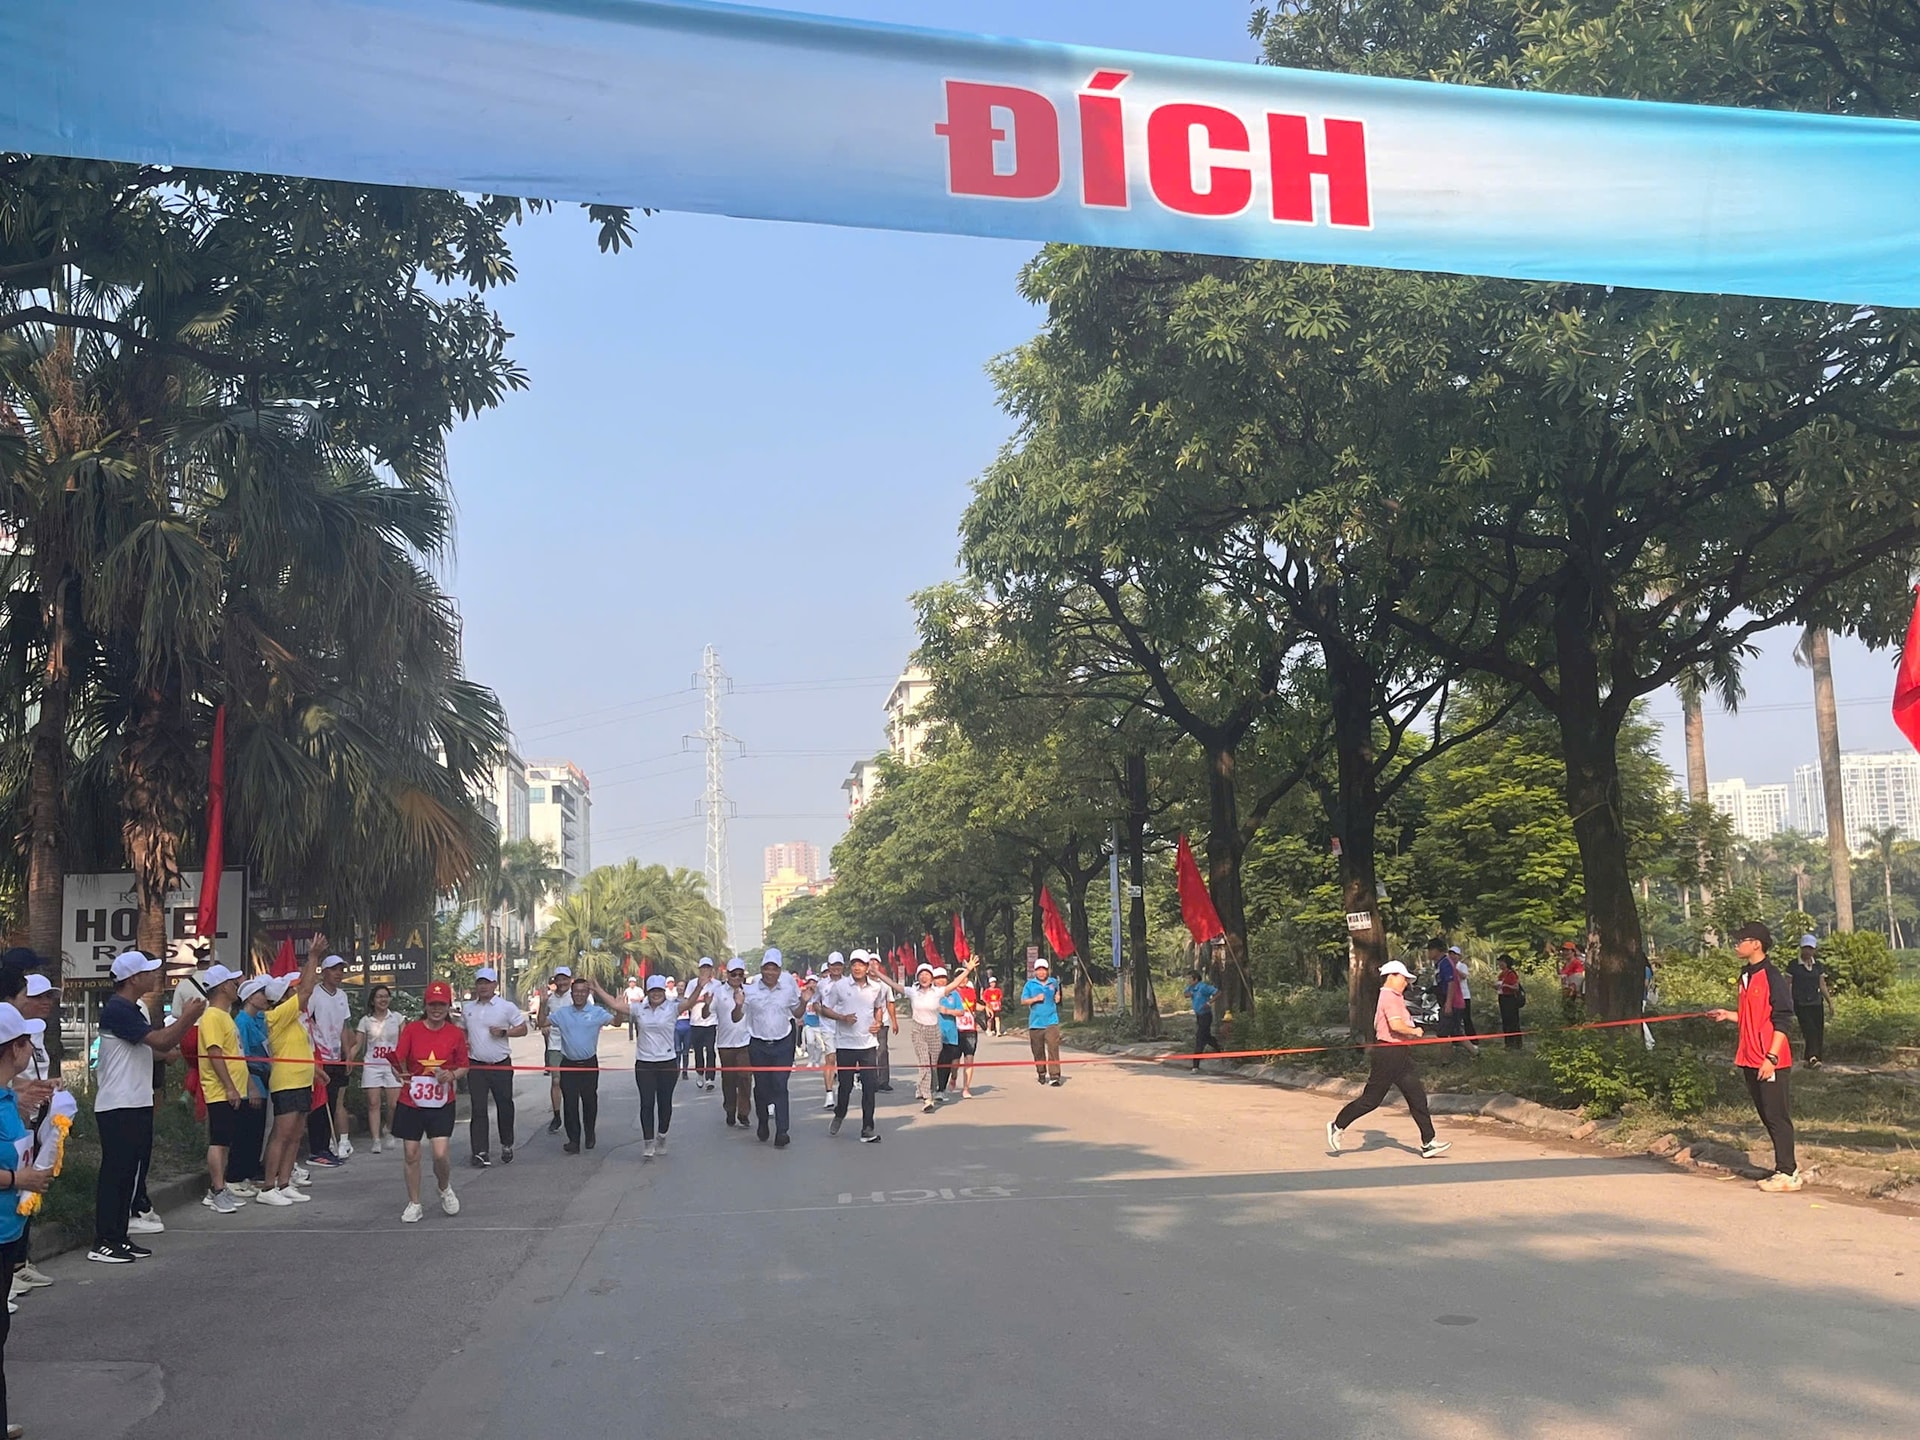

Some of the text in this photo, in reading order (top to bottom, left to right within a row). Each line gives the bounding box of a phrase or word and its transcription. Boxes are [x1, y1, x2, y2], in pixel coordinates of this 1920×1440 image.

[934, 70, 1373, 228] ĐÍCH
[76, 907, 228, 942] HOE
[414, 1083, 444, 1101] 339
